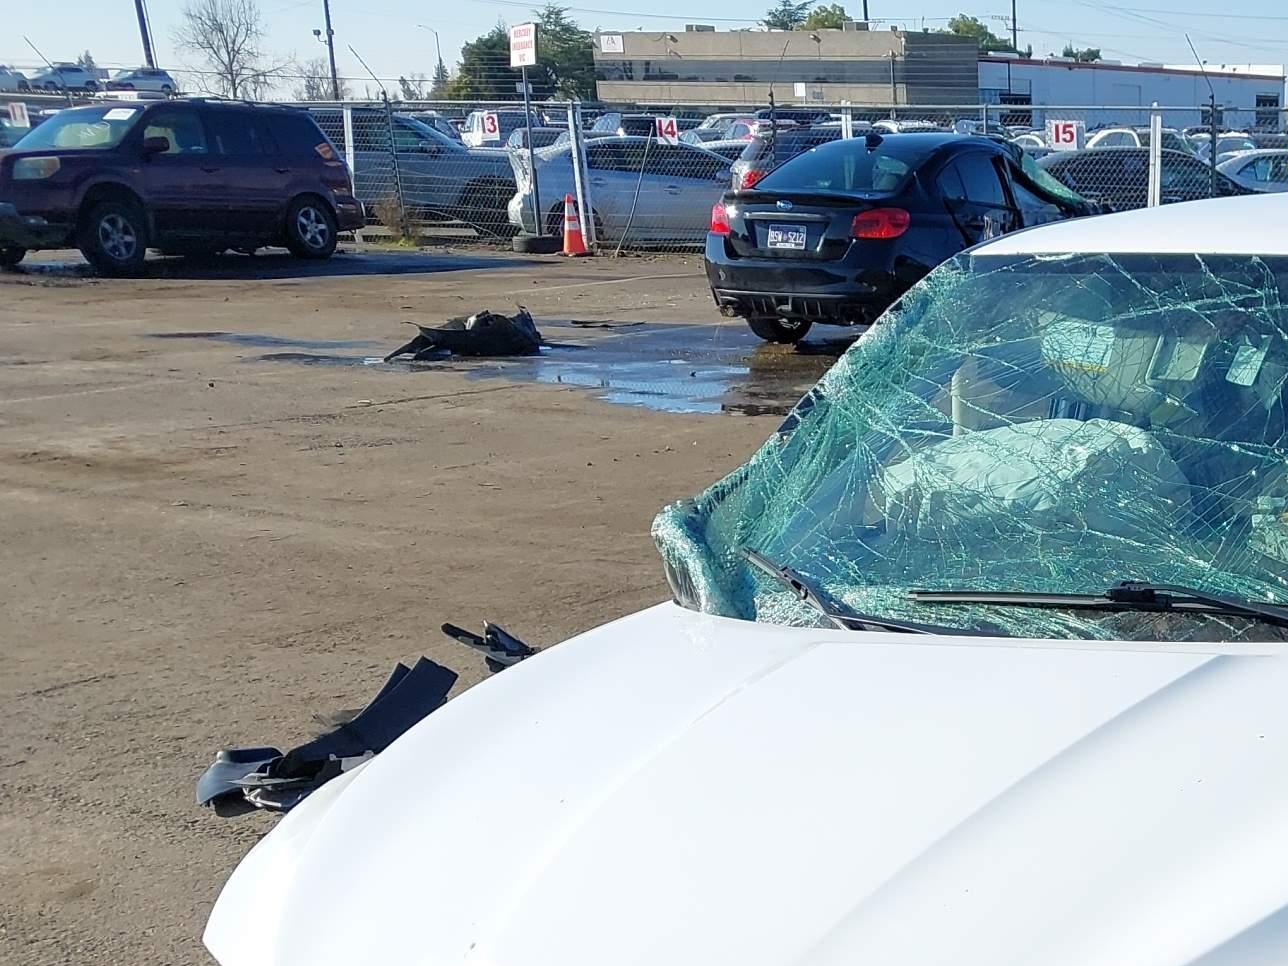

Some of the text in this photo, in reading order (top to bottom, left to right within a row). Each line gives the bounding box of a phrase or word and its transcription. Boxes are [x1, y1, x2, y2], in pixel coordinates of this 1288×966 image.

[481, 116, 497, 133] 13
[658, 120, 676, 138] 14
[1054, 124, 1074, 143] 15
